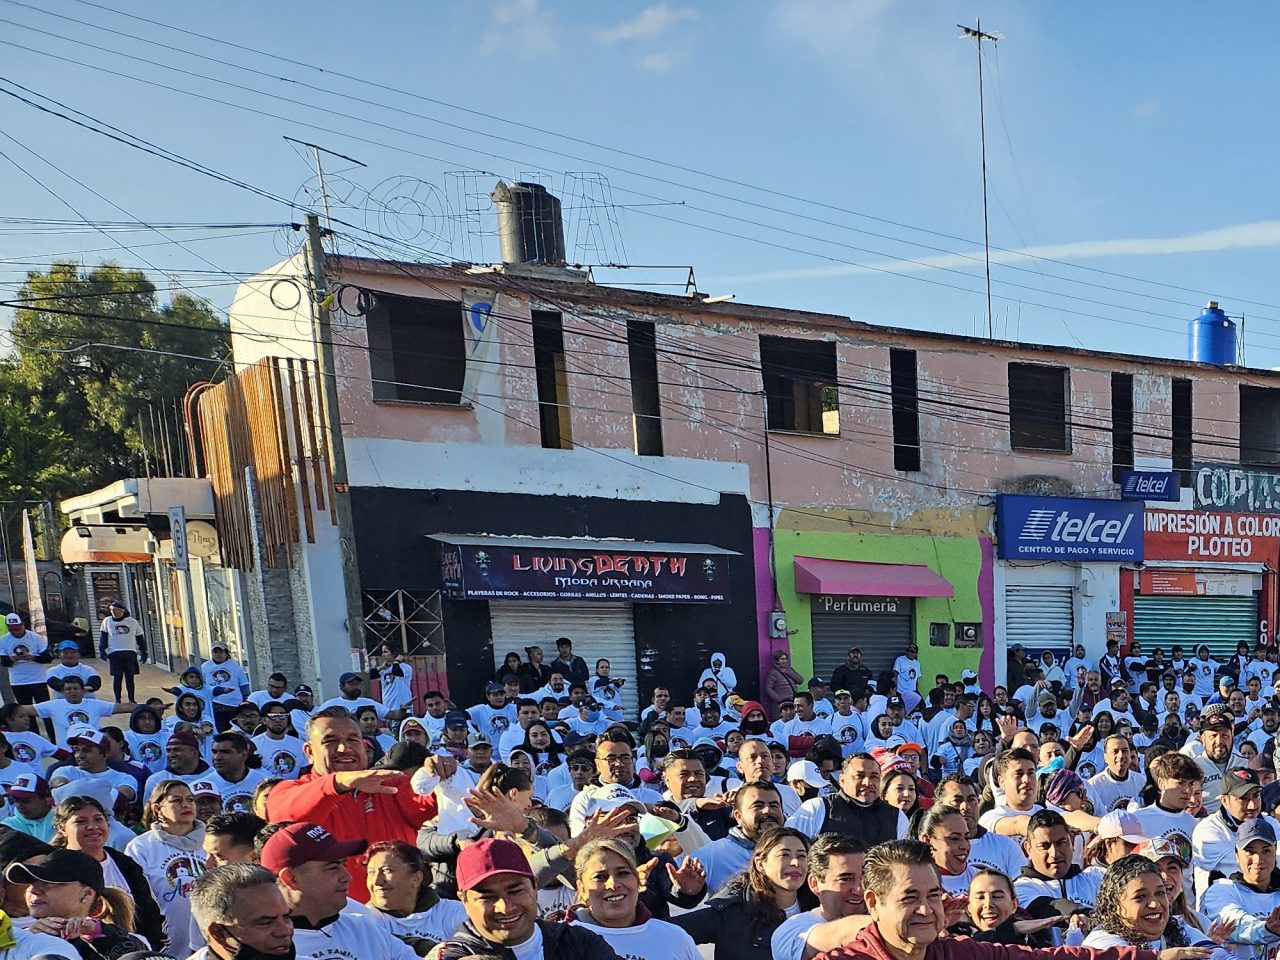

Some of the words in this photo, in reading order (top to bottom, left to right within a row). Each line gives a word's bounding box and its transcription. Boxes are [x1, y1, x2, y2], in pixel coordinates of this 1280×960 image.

[1136, 476, 1168, 493] telcel
[1051, 511, 1134, 543] telcel
[1144, 512, 1220, 535] IMPRESIÓN
[1224, 516, 1234, 535] A
[1238, 517, 1280, 537] COLOR
[1019, 546, 1052, 554] CENTRO
[1055, 546, 1065, 554] DE
[1098, 548, 1135, 556] SERVICIO
[1188, 536, 1251, 557] PLOTEO
[555, 577, 598, 588] MODA
